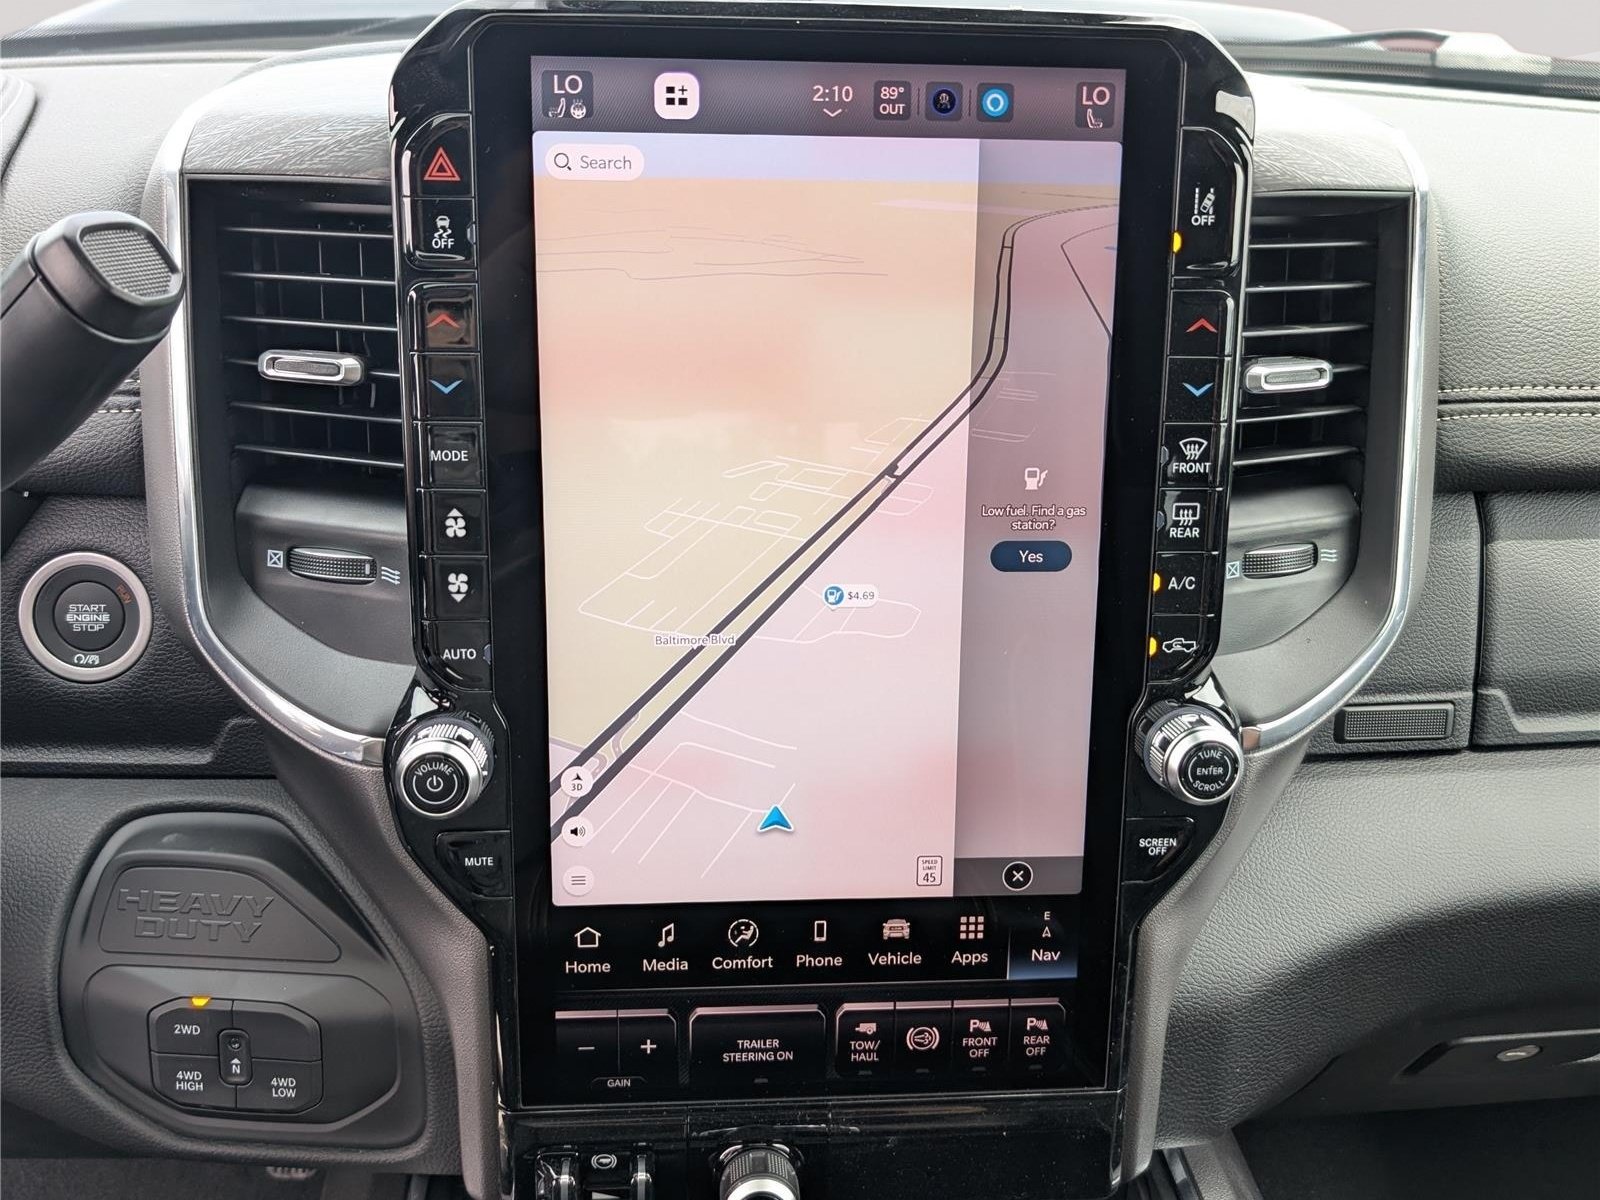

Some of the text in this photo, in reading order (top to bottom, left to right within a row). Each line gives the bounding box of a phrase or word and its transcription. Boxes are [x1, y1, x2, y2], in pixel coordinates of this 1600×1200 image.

[553, 75, 583, 94] LO
[812, 85, 853, 103] 2:10
[880, 86, 905, 100] 89°
[1082, 86, 1110, 106] LO
[879, 103, 906, 115] OUT
[580, 154, 632, 171] Search
[1192, 215, 1216, 226] OFF
[432, 238, 455, 250] OFF
[430, 450, 469, 462] MODE
[1172, 462, 1212, 474] FRONT
[982, 504, 1086, 518] Low fuel. Find a gas
[1012, 518, 1056, 530] station?
[1169, 528, 1200, 538] REAR
[1019, 550, 1044, 563] Yes
[1168, 576, 1196, 591] A/C
[848, 590, 875, 600] $4.69
[68, 604, 106, 612] START
[66, 614, 110, 622] ENGINE
[72, 624, 104, 632] STOP
[655, 634, 736, 646] Baltimore Blvd
[442, 648, 476, 660] AUTO
[1198, 750, 1222, 760] TUNE
[414, 762, 454, 777] VOLUME
[1196, 766, 1224, 776] ENTER
[571, 783, 583, 792] 3D
[1192, 780, 1226, 792] SCROLL
[1138, 837, 1177, 848] SCREEN
[1148, 846, 1167, 856] OFF
[464, 856, 494, 867] MUTE
[922, 872, 936, 883] 45
[117, 888, 276, 918] HEAVY
[1044, 912, 1051, 920] E
[134, 916, 263, 942] DUTY
[796, 954, 843, 968] Phone
[868, 952, 922, 966] Vehicle
[951, 950, 988, 966] Apps
[1031, 949, 1061, 962] Nav
[565, 960, 611, 974] Home
[642, 958, 689, 972] Media
[712, 955, 773, 970] Comfort
[174, 1024, 201, 1036] 2WD
[736, 1038, 780, 1050] TRAILER
[850, 1040, 880, 1051] TOW/
[962, 1036, 998, 1047] FRONT
[1023, 1035, 1050, 1045] REAR
[722, 1050, 794, 1062] STEERING ON
[850, 1051, 879, 1062] HAUL
[968, 1048, 990, 1058] OFF
[1026, 1046, 1046, 1056] OFF
[232, 1064, 241, 1074] N
[176, 1070, 202, 1081] 4WD
[176, 1080, 204, 1092] HIGH
[271, 1076, 296, 1088] 4WD
[607, 1078, 631, 1088] GAIN
[272, 1087, 297, 1098] LOW
